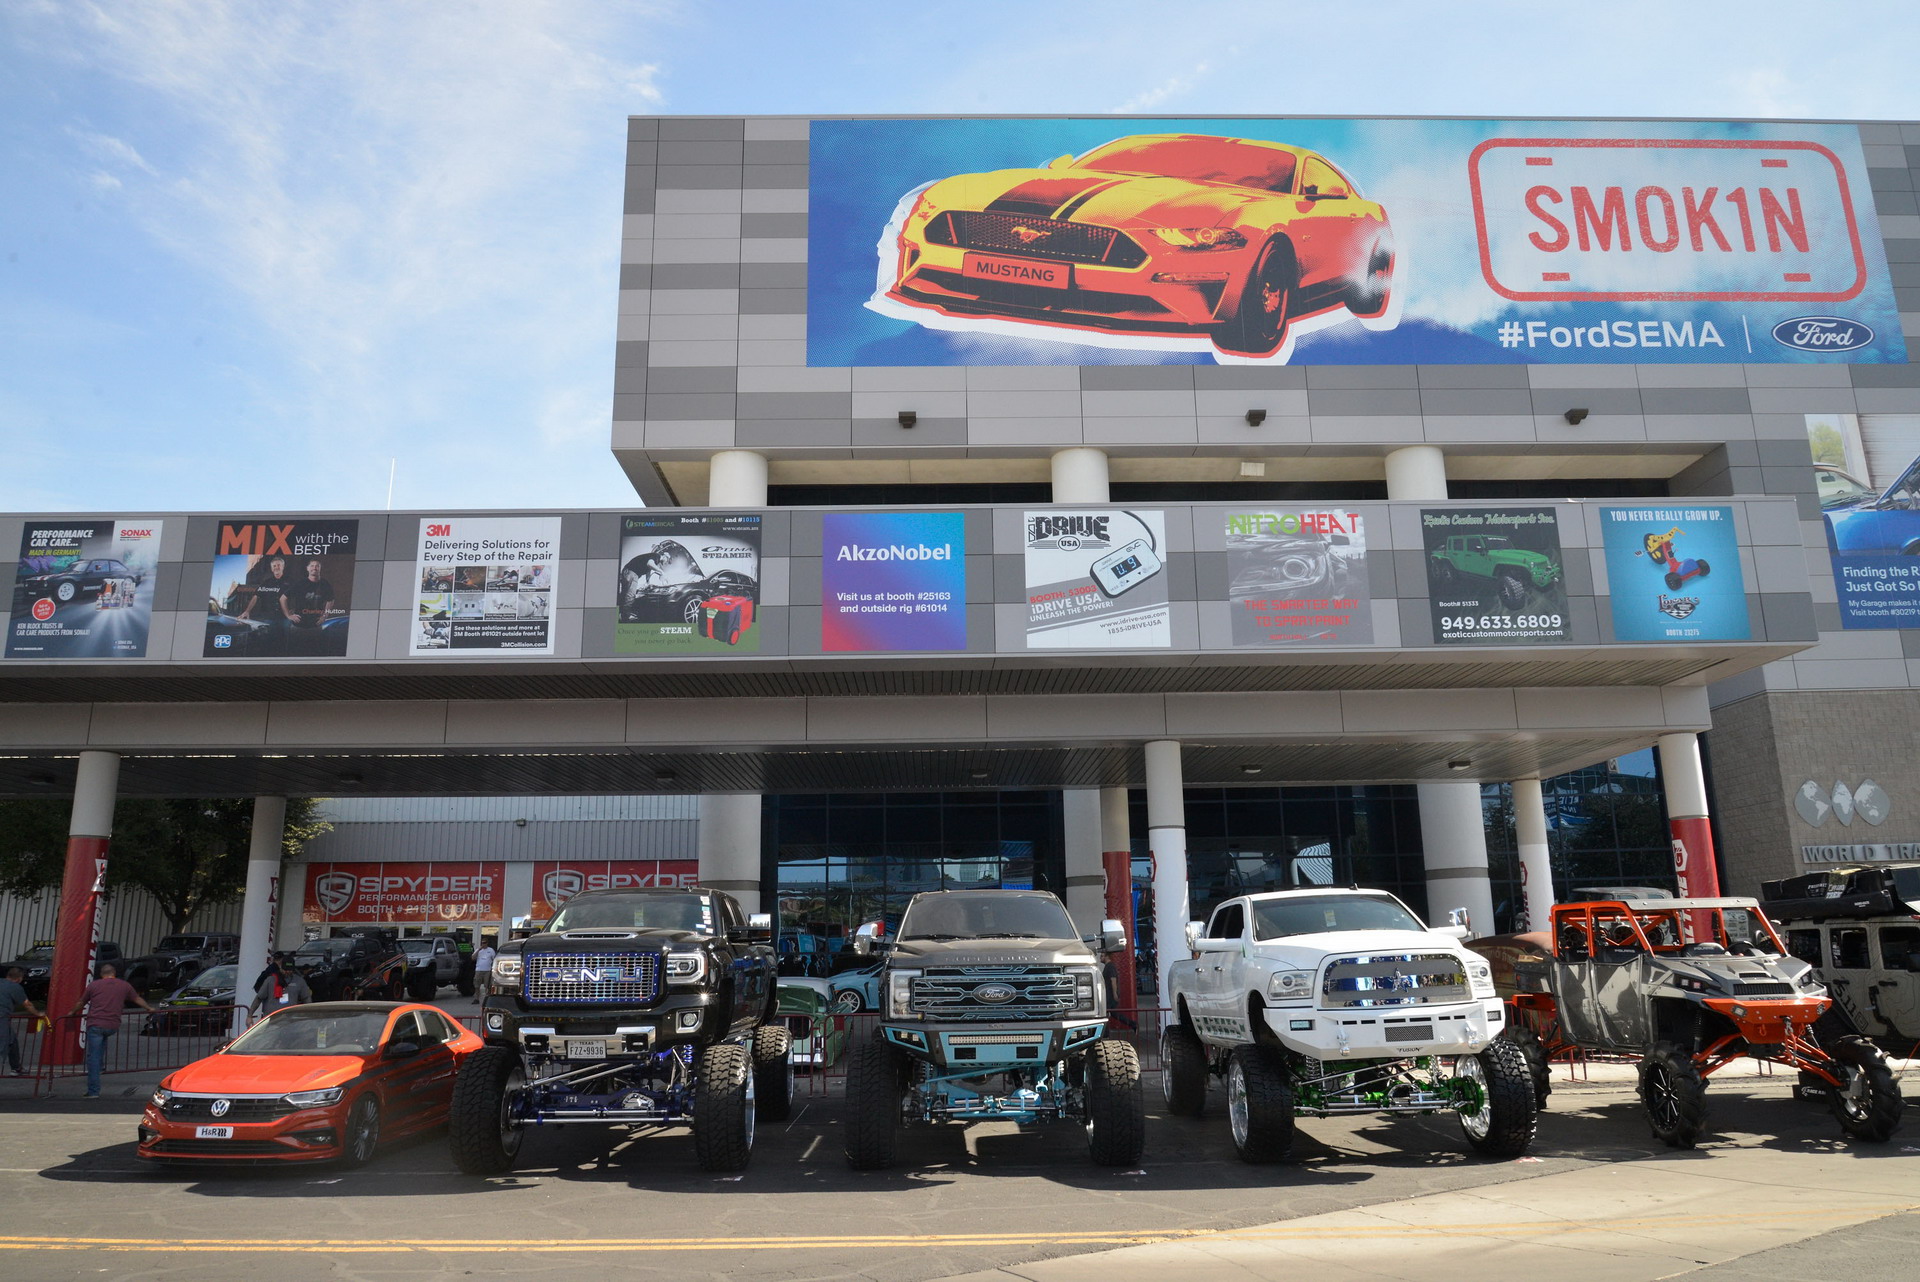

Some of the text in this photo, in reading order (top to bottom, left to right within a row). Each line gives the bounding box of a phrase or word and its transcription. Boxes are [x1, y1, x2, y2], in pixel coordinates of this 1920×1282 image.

[1524, 185, 1810, 254] SMOK1N
[975, 260, 1056, 283] MUSTANG
[1498, 320, 1725, 349] #FordSEMA
[1792, 321, 1855, 346] Ford
[1610, 510, 1723, 521] YOU NEVER REALLY GROW UP.
[31, 529, 94, 538] PERFORMANCE
[426, 524, 451, 536] 3M
[30, 538, 48, 547] CAR
[220, 525, 349, 556] MIX with the
[425, 540, 550, 551] Delivering Solutions for
[294, 544, 330, 556] BEST
[837, 544, 951, 561] AkzoNobel
[424, 551, 553, 562] Every Step of the Repair
[1843, 567, 1887, 579] Finding
[1889, 567, 1909, 576] the
[1846, 581, 1915, 592] Just Got So
[837, 592, 858, 601] Visit
[887, 592, 914, 600] booth
[917, 592, 950, 600] #25163
[1030, 592, 1066, 603] BOOTH:
[840, 604, 947, 613] and outside rig #61014
[1032, 592, 1102, 614] iDRIVE USA
[1243, 599, 1359, 610] THE SMARTER WAY
[1030, 601, 1114, 622] UNLEASH THE POWER!
[1100, 611, 1167, 628] www.idrive-usa.com
[1255, 615, 1350, 627] TO SPRAYPAINT
[1441, 614, 1562, 630] 949.633.6809
[1108, 619, 1162, 635] 1855-iDRIVE-USA
[1443, 630, 1563, 639] exoticcustommotorsports.com
[359, 876, 493, 892] SPYDER
[358, 905, 391, 914] BOOTH
[984, 989, 1005, 998] Ford
